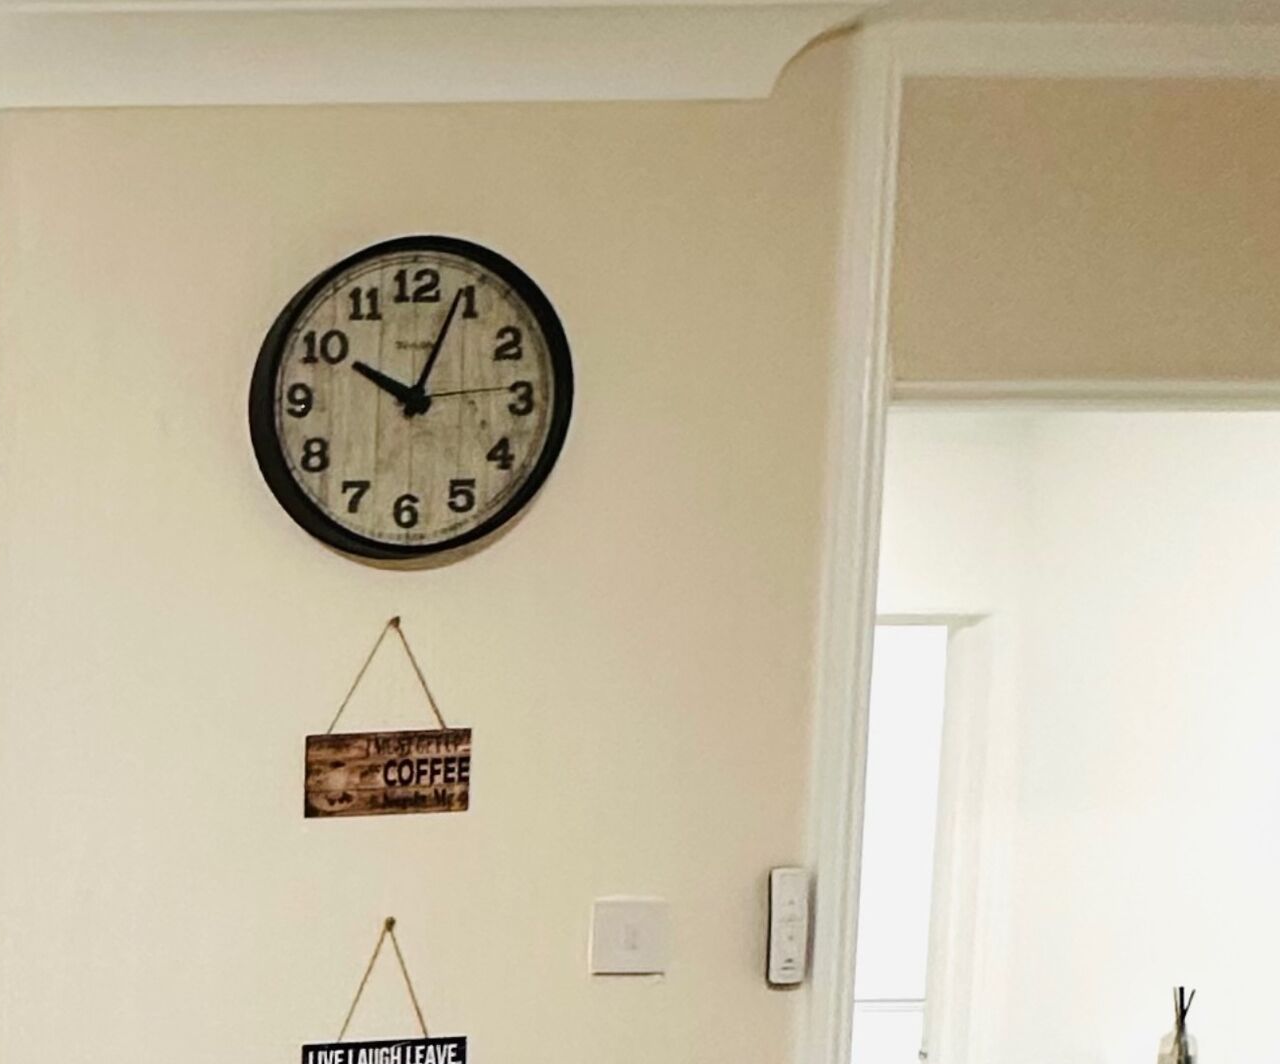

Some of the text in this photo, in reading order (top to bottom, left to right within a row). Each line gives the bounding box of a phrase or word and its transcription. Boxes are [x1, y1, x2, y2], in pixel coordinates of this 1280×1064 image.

[393, 268, 441, 303] 12
[462, 285, 478, 318] 1
[348, 287, 382, 320] 11
[302, 330, 349, 364] 10
[493, 326, 523, 361] 2
[287, 383, 313, 418] 9
[508, 381, 534, 416] 3
[301, 438, 330, 472] 8
[486, 437, 515, 470] 4
[341, 480, 370, 513] 7
[393, 494, 419, 528] 6
[448, 478, 476, 513] 5
[383, 757, 470, 786] COFFEE
